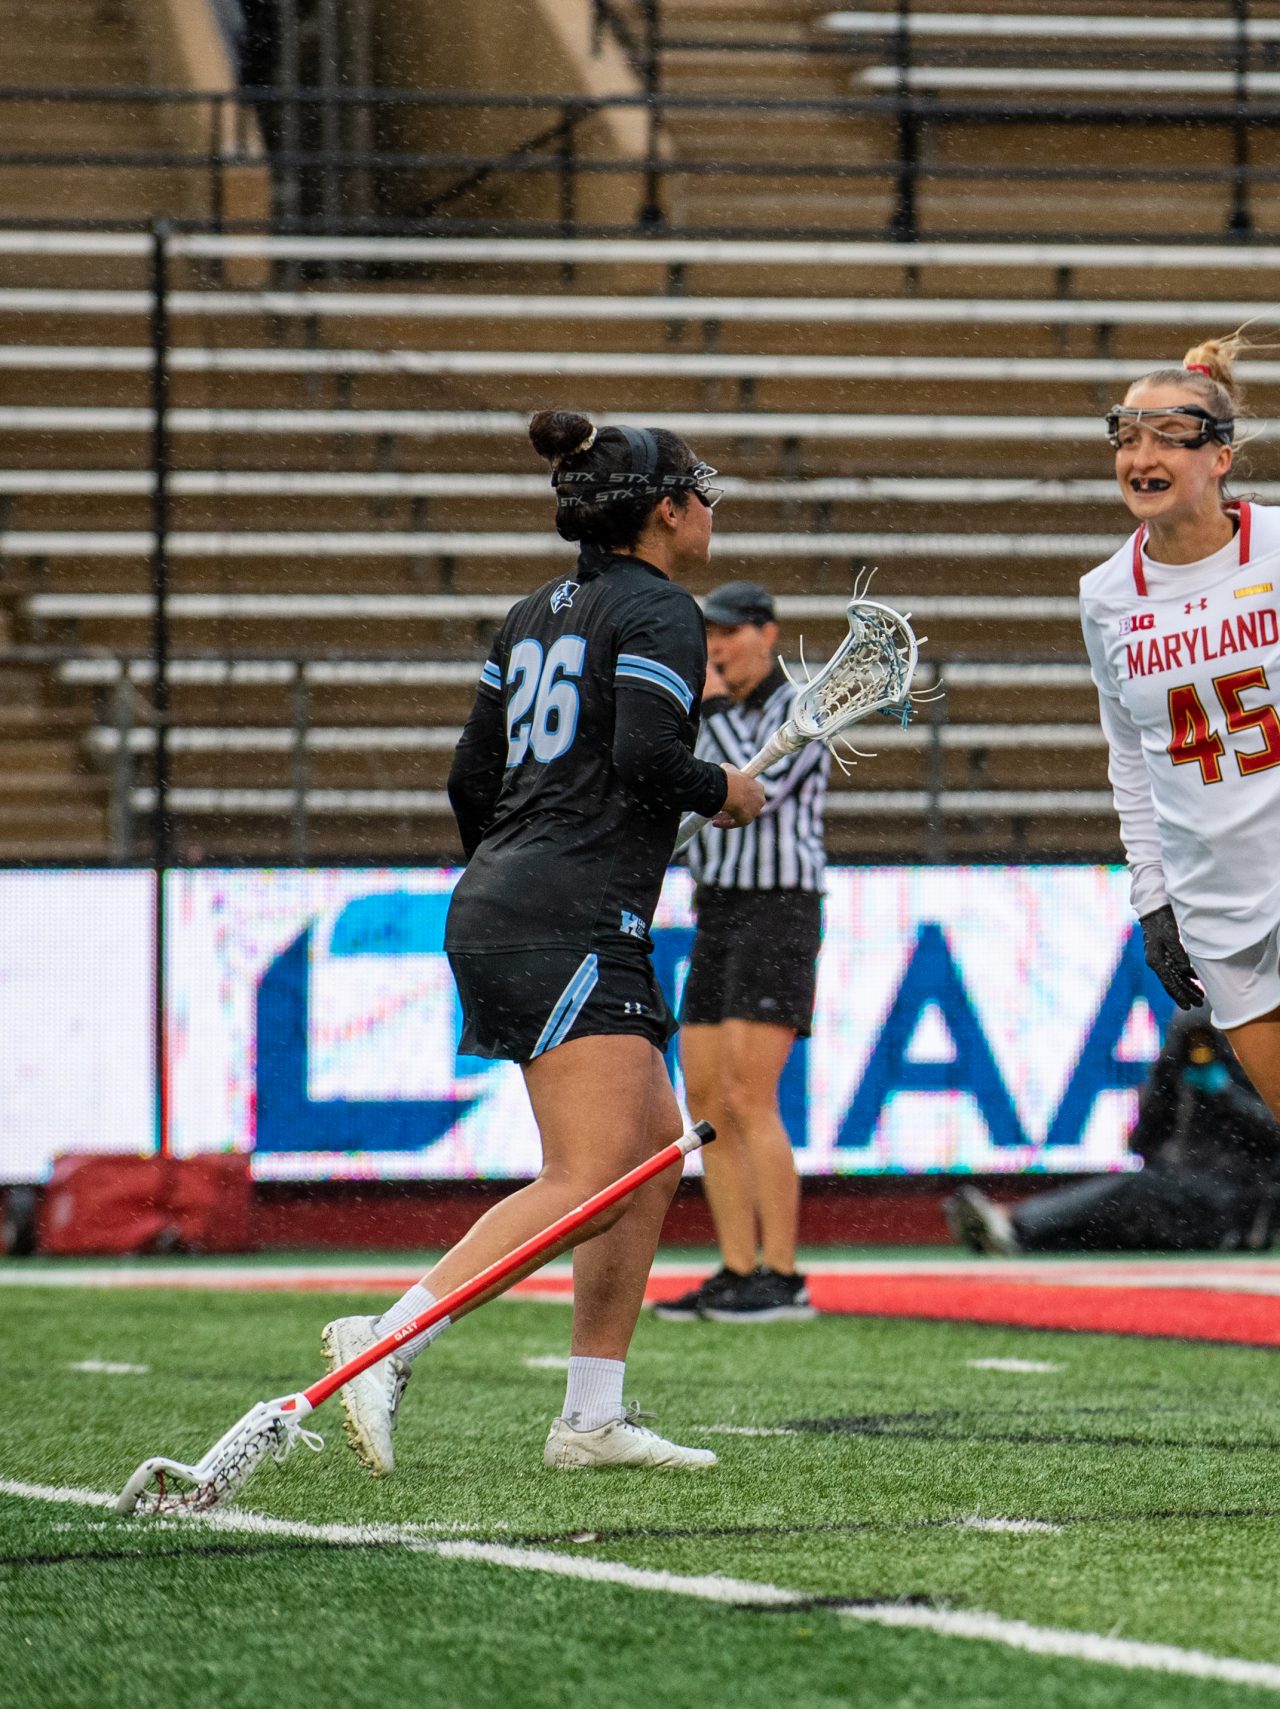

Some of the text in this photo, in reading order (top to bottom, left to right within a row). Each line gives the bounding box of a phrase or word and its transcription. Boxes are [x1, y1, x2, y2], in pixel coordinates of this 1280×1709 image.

[564, 472, 596, 482] STX
[609, 473, 650, 484] STX
[560, 495, 587, 508] STX
[595, 487, 635, 503] STX
[1125, 608, 1280, 680] MARYLAND
[506, 634, 588, 768] 26
[394, 1321, 418, 1341] GAIT
